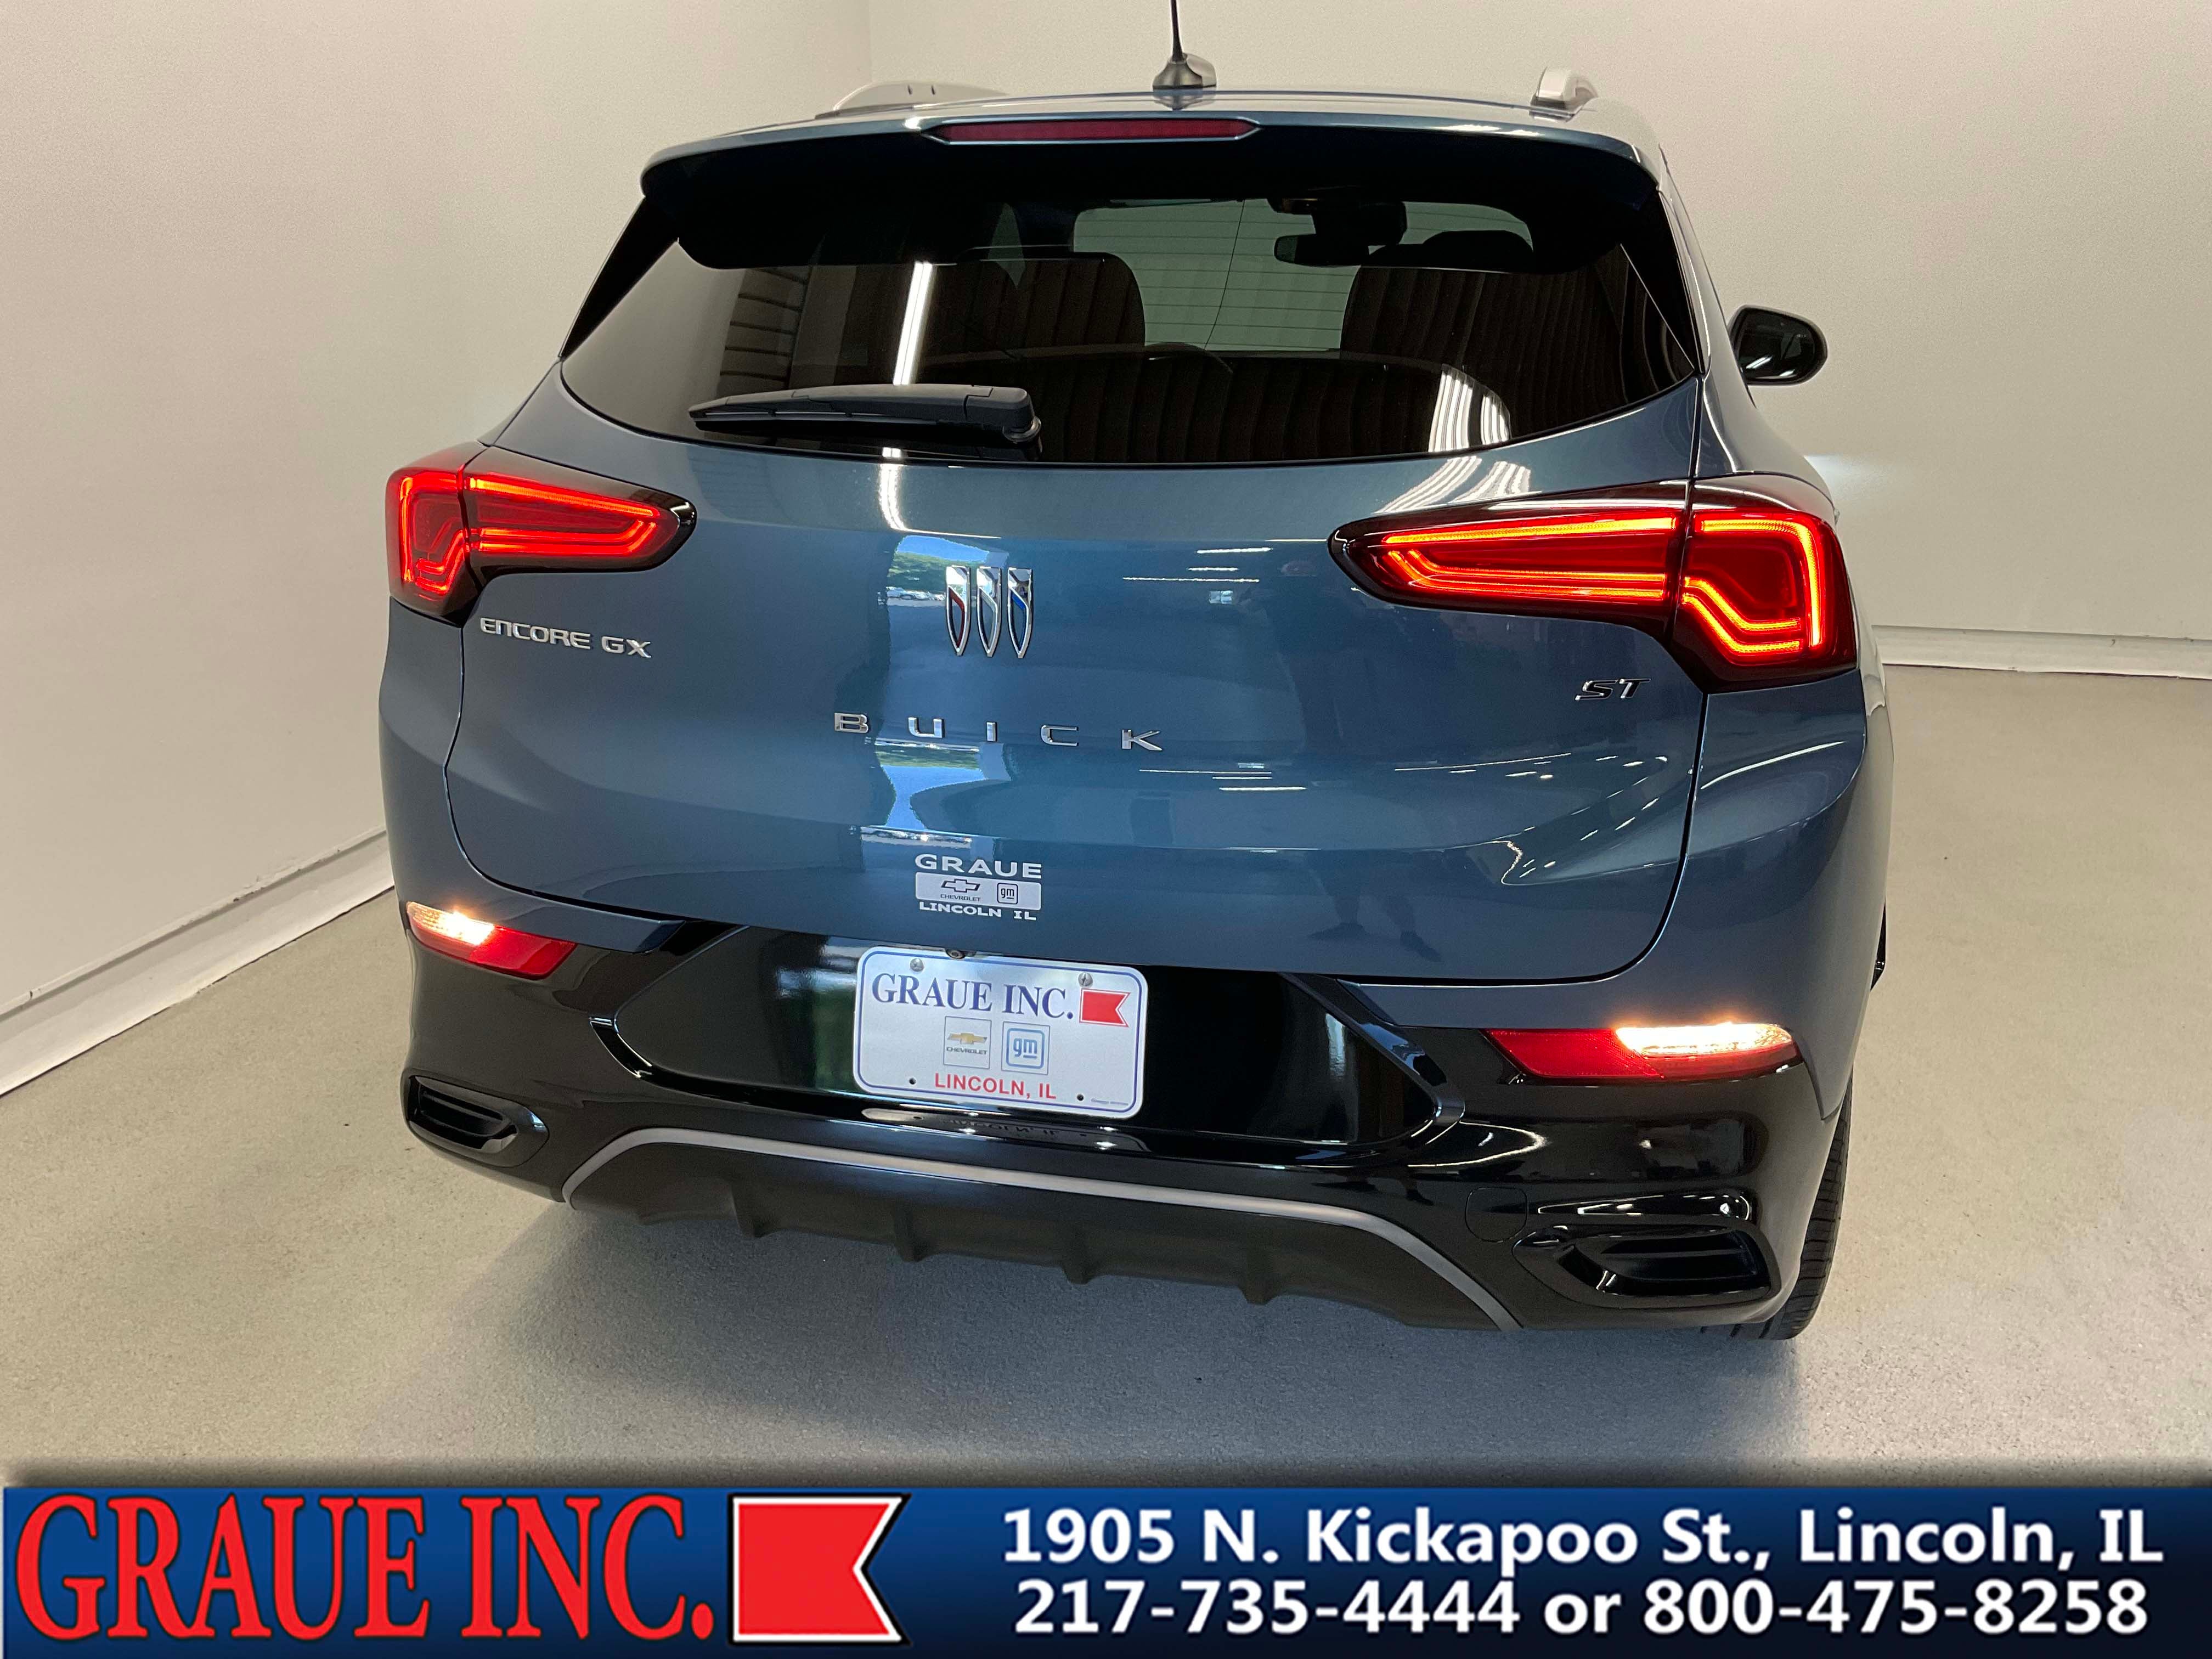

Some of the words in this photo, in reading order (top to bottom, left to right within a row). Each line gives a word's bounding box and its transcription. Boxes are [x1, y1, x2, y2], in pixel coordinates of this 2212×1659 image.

[480, 617, 591, 650] ENCORE
[601, 636, 652, 658] GX
[1575, 678, 1651, 701] ST
[834, 712, 1163, 751] BUICK
[915, 854, 1042, 879] GRAUE
[940, 893, 981, 902] CHEVROLET
[1000, 888, 1015, 899] gm
[919, 901, 1002, 918] LINCOLN
[1013, 910, 1037, 921] IL
[872, 973, 992, 1011] GRAUE
[1002, 984, 1074, 1019] INC.
[946, 1046, 988, 1056] CHEVROLET
[1013, 1037, 1038, 1058] gm
[934, 1073, 1031, 1099] LINCOLN,
[1039, 1084, 1057, 1099] IL
